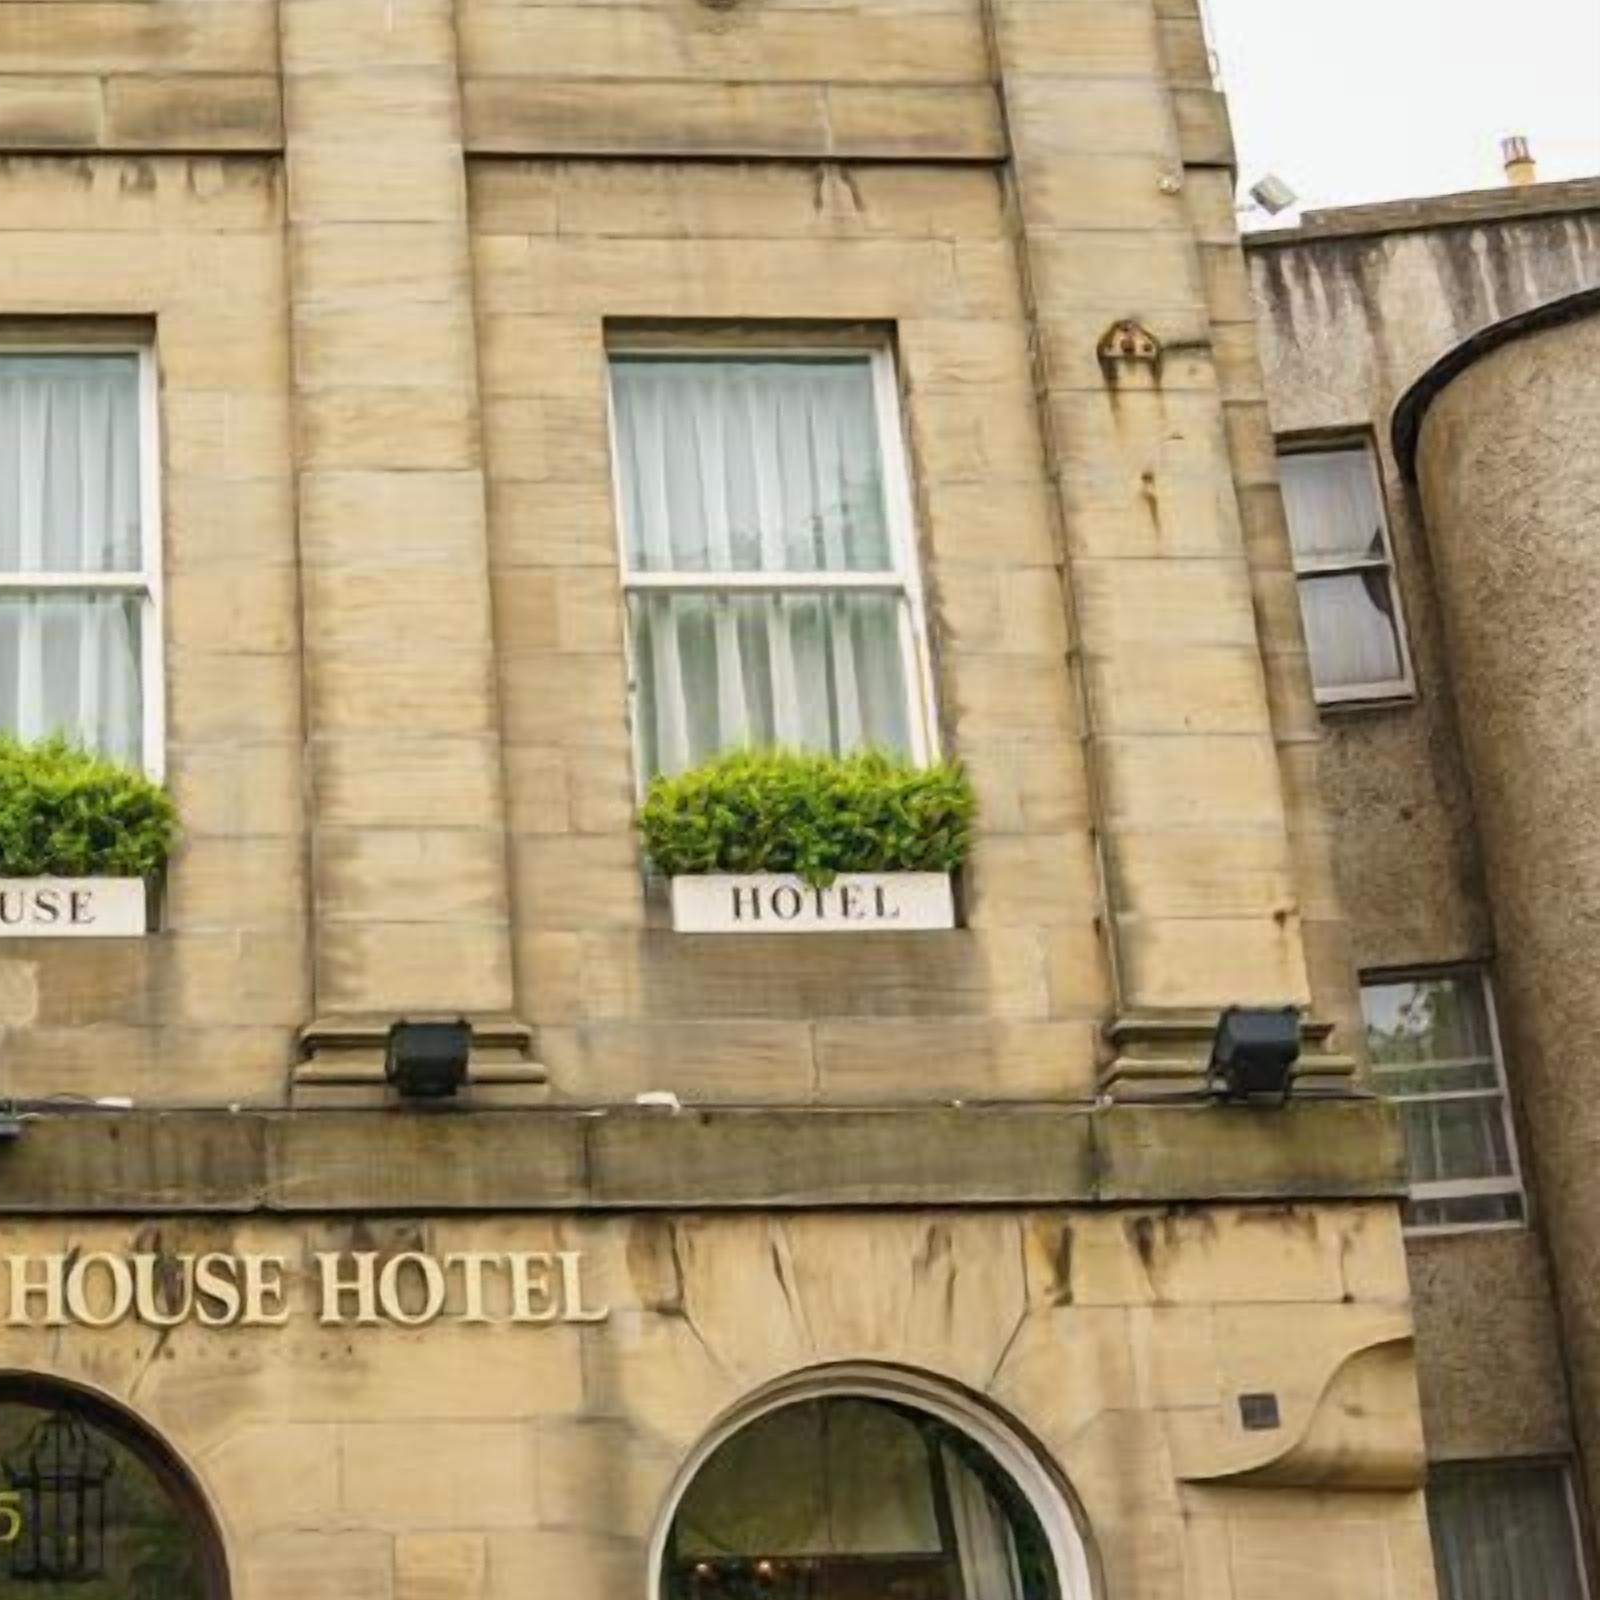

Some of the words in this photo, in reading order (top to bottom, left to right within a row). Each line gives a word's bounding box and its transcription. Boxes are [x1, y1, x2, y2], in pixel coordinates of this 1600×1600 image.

[731, 884, 901, 921] HOTEL
[3, 1250, 292, 1328] HOUSE
[314, 1250, 612, 1327] HOTEL
